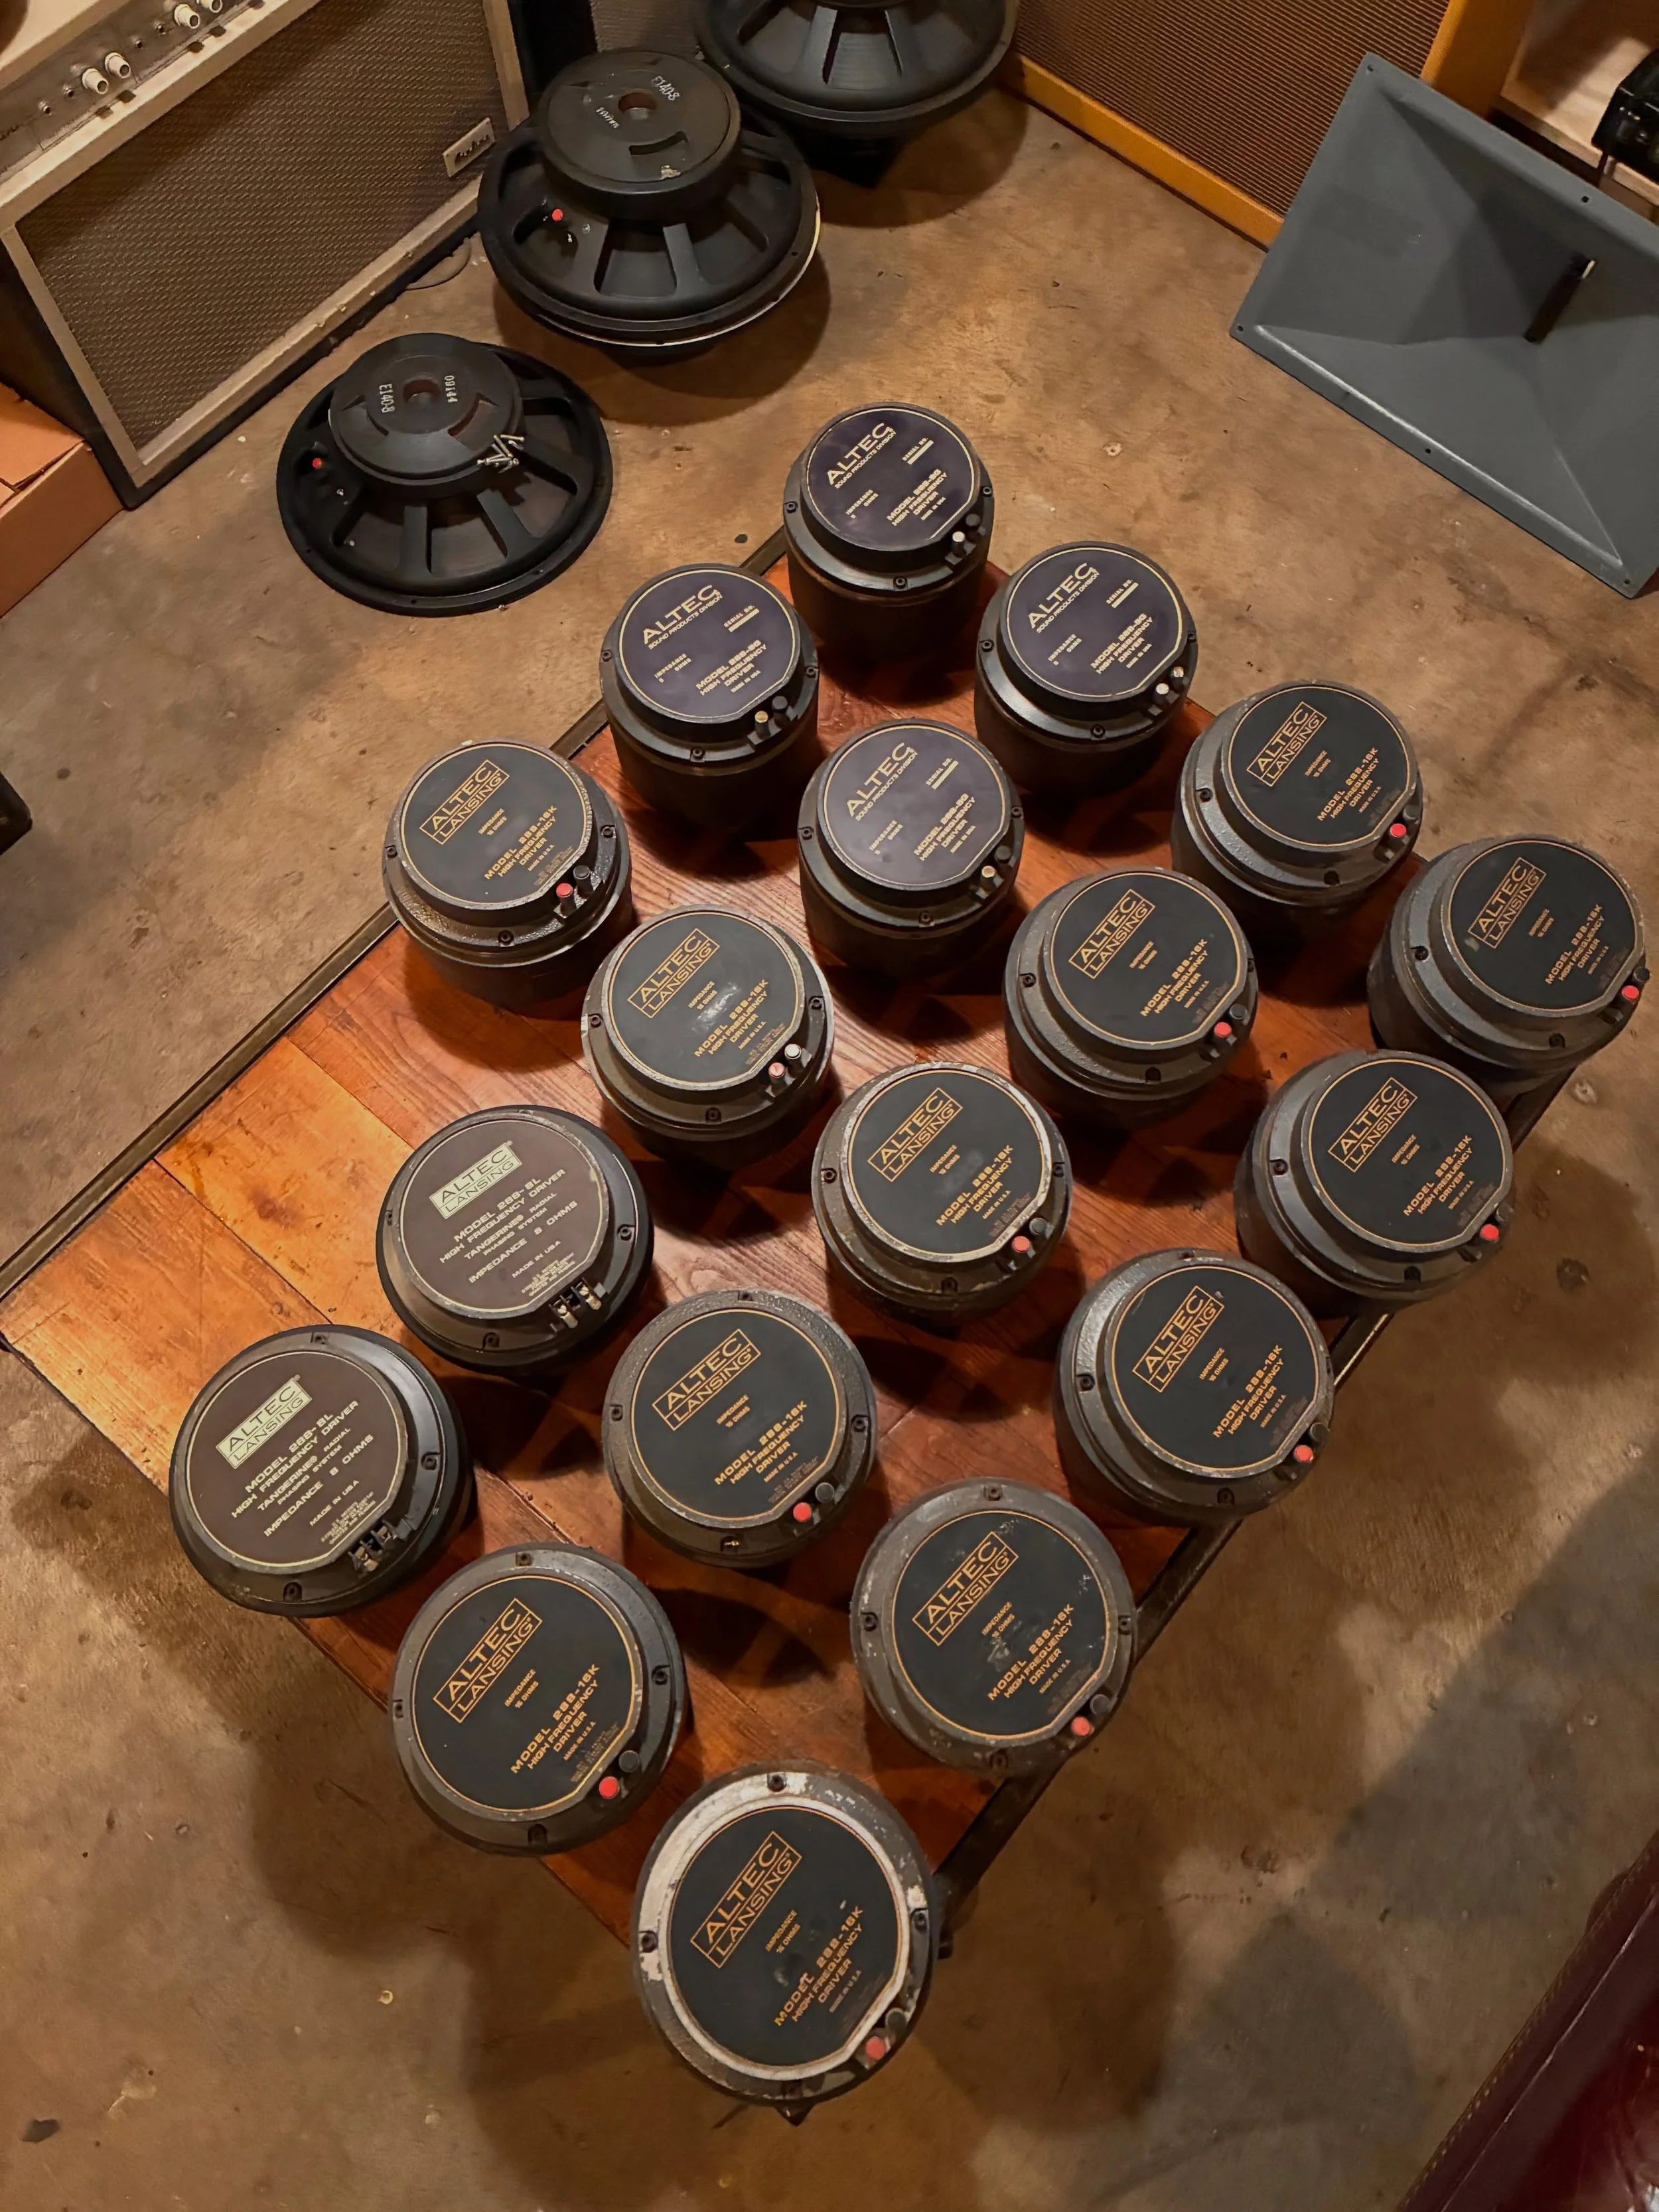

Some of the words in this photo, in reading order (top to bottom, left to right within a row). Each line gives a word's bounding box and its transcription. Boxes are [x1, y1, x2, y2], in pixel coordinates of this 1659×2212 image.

[827, 422, 892, 485] ALTEC
[887, 496, 916, 521] MODEL
[643, 585, 719, 644] ALTEC
[648, 632, 669, 650] SOUND
[668, 611, 699, 635] PRODUCTS
[698, 593, 723, 613] DIVISION
[1028, 562, 1095, 629] ALTEC
[1036, 615, 1054, 634] SOUND
[1052, 590, 1080, 617] PRODUCTS
[1078, 570, 1100, 593] DIVISION
[720, 644, 766, 681] FREQUENCY
[1090, 642, 1120, 669] MODEL
[1113, 617, 1153, 658] FREQUENCY
[1118, 636, 1145, 663] DRIVER
[695, 665, 729, 690] MODEL
[723, 663, 755, 687] DRIVER
[1257, 709, 1309, 773] ALTEC
[1266, 717, 1320, 780] LANSING
[432, 767, 492, 830] ALTEC
[439, 775, 502, 838] LANSING
[846, 742, 913, 817] ALTEC
[855, 800, 874, 822] SOUND
[871, 773, 899, 803] PRODUCTS
[897, 750, 918, 774] DIVISION
[1317, 790, 1346, 821] MODEL
[1330, 800, 1347, 818] HIGH
[1343, 758, 1379, 802] FREQUENCY
[1349, 779, 1374, 807] DRIVER
[498, 858, 517, 877] HIGH
[514, 816, 556, 859] FREQUENCY
[913, 826, 943, 855] MODEL
[936, 796, 975, 842] FREQUENCY
[941, 819, 968, 848] DRIVER
[484, 849, 518, 880] MODEL
[519, 838, 547, 865] DRIVER
[1080, 897, 1137, 964] ALTEC
[1090, 906, 1148, 972] LANSING
[640, 936, 701, 1003] ALTEC
[648, 946, 712, 1011] LANSING
[1154, 994, 1173, 1014] HIGH
[1169, 950, 1208, 996] FREQUENCY
[1175, 972, 1201, 1002] DRIVER
[708, 1035, 728, 1055] HIGH
[725, 990, 767, 1037] FREQUENCY
[729, 1013, 758, 1043] DRIVER
[1140, 984, 1172, 1017] MODEL
[694, 1025, 728, 1057] MODEL
[881, 1095, 944, 1165] ALTEC
[889, 1106, 954, 1174] LANSING
[1340, 1085, 1398, 1155] ALTEC
[1350, 1096, 1410, 1165] LANSING
[441, 1149, 508, 1204] ALTEC
[445, 1160, 514, 1213] LANSING
[530, 1193, 557, 1213] RADIAL
[950, 1203, 971, 1224] HIGH
[968, 1157, 1012, 1205] FREQUENCY
[973, 1181, 1003, 1213] DRIVER
[1403, 1182, 1435, 1217] MODEL
[1417, 1193, 1436, 1214] HIGH
[1432, 1147, 1473, 1195] FREQUENCY
[1438, 1171, 1466, 1203] DRIVER
[439, 1242, 465, 1264] HIGH
[467, 1197, 525, 1243] FREQUENCY
[528, 1169, 565, 1198] DRIVER
[453, 1212, 496, 1242] MODEL
[482, 1230, 516, 1256] PHASING
[518, 1207, 547, 1230] SYSTEM
[936, 1192, 972, 1226] MODEL
[468, 1238, 528, 1284] IMPEDANCE
[534, 1226, 543, 1235] 8
[546, 1201, 577, 1226] OHMS
[512, 1260, 534, 1278] MADE
[544, 1240, 561, 1254] USA
[1145, 1294, 1204, 1374] ALTEC
[1155, 1305, 1216, 1384] LANSING
[668, 1337, 742, 1410] ALTEC
[673, 1351, 752, 1422] LANSING
[1228, 1411, 1247, 1435] HIGH
[1243, 1358, 1283, 1413] FREQUENCY
[1250, 1385, 1277, 1420] DRIVER
[230, 1386, 296, 1452] ALTEC
[234, 1397, 303, 1461] LANSING
[323, 1428, 351, 1452] RADIAL
[1212, 1399, 1246, 1438] MODEL
[231, 1493, 257, 1518] HIGH
[259, 1436, 318, 1493] FREQUENCY
[321, 1400, 358, 1436] DRIVER
[245, 1456, 288, 1493] MODEL
[277, 1474, 310, 1505] PHASING
[312, 1444, 342, 1473] SYSTEM
[714, 1449, 756, 1485] MODEL
[729, 1462, 753, 1484] HIGH
[751, 1415, 804, 1465] FREQUENCY
[755, 1441, 791, 1473] DRIVER
[263, 1481, 323, 1537] IMPEDANCE
[329, 1467, 339, 1476] 8
[342, 1434, 374, 1465] OHMS
[309, 1505, 332, 1526] MADE
[332, 1495, 342, 1505] IN
[342, 1480, 360, 1496] USA
[927, 1541, 998, 1625] ALTEC
[936, 1555, 1010, 1636] LANSING
[448, 1608, 521, 1702] ALTEC
[457, 1621, 534, 1712] LANSING
[987, 1660, 1027, 1701] MODEL
[1003, 1673, 1027, 1698] HIGH
[1023, 1619, 1073, 1676] FREQUENCY
[1029, 1648, 1062, 1685] DRIVER
[504, 1668, 536, 1707] IMPEDANCE
[521, 1680, 539, 1702] OHMS
[510, 1728, 551, 1774] MODEL
[527, 1742, 551, 1769] HIGH
[547, 1679, 598, 1743] FREQUENCY
[553, 1711, 587, 1752] DRIVER
[705, 1842, 780, 1945] ALTEC
